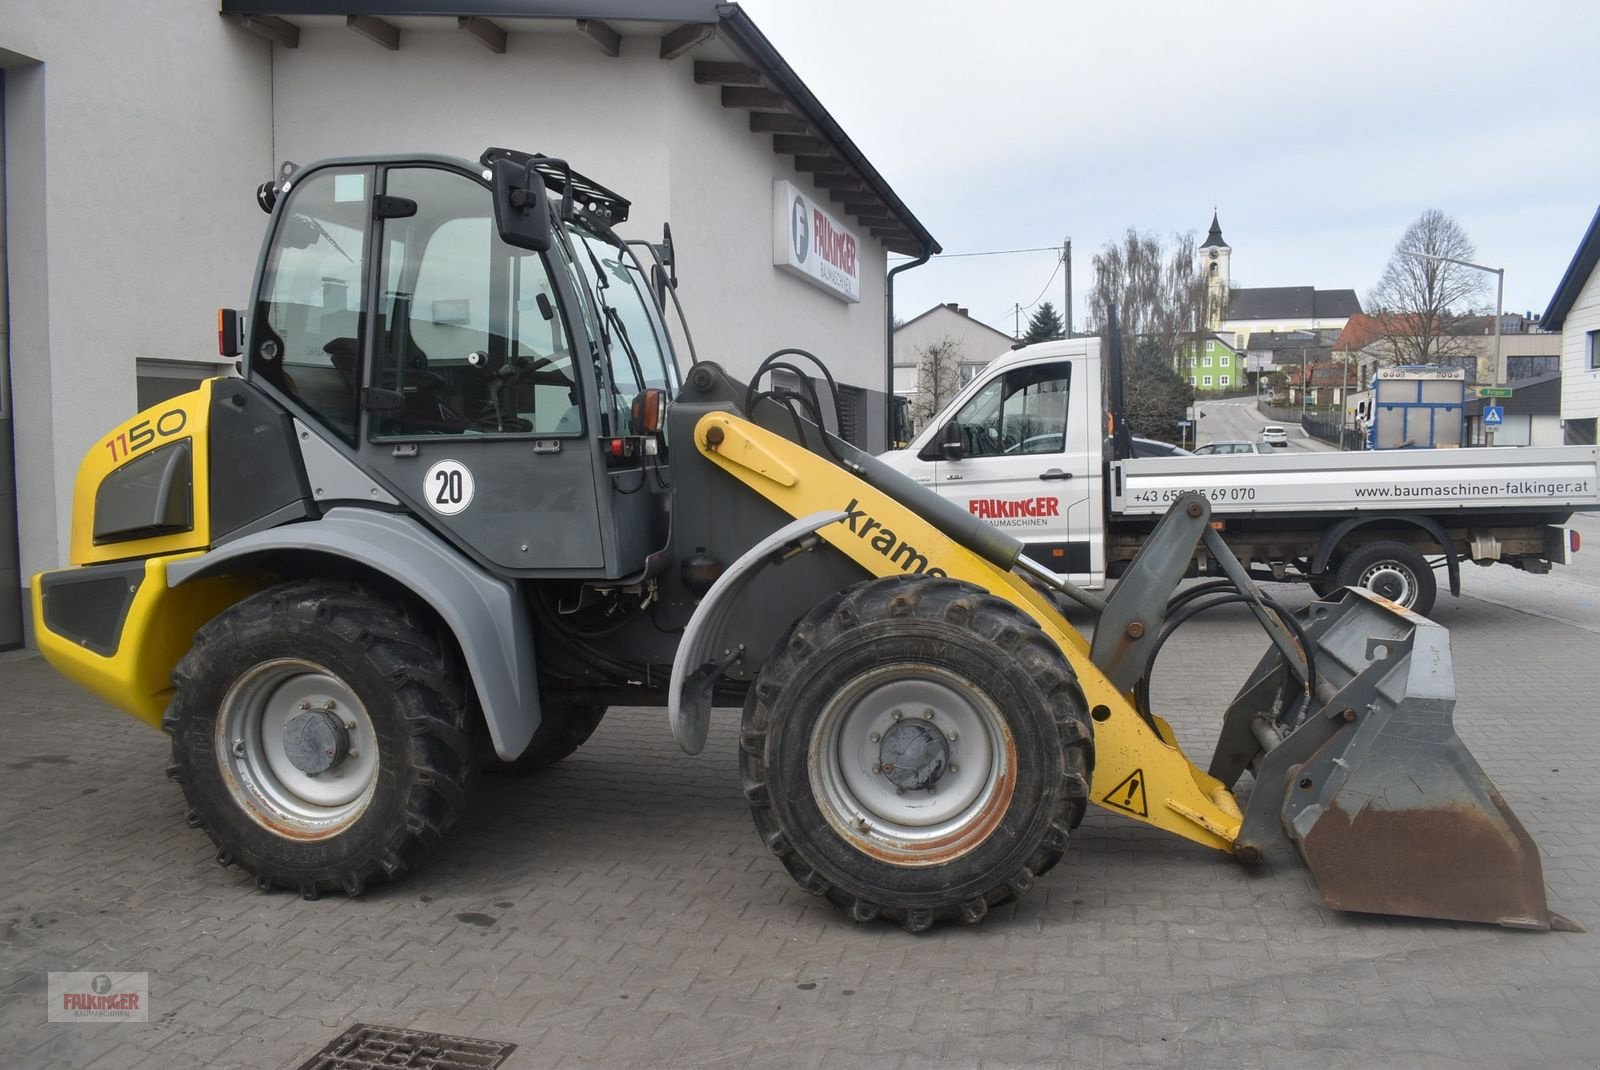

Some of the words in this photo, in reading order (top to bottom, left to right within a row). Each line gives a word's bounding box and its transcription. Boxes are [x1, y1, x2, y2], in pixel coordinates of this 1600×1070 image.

[813, 208, 856, 278] FALKINGER
[106, 409, 187, 463] 1150
[435, 469, 464, 504] 20
[1134, 490, 1158, 502] +43
[1211, 488, 1227, 500] 69
[1231, 488, 1255, 500] 070
[1355, 481, 1588, 498] www.baumaschinen-falkinger.at
[969, 496, 1060, 519] FALKINGER
